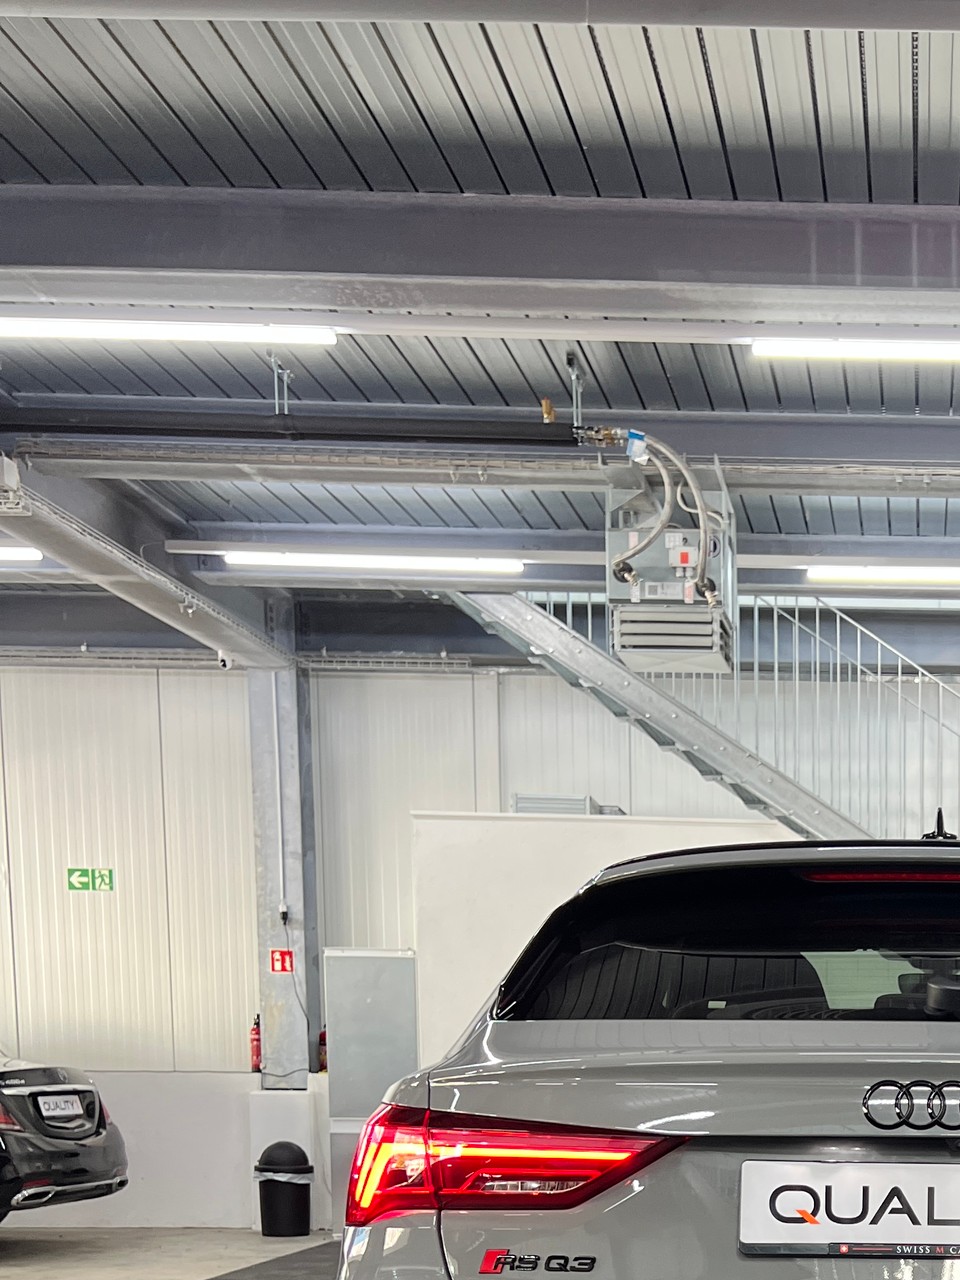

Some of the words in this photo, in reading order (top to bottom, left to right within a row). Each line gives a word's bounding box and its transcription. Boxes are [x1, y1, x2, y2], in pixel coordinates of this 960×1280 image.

[896, 1245, 931, 1254] SWISS
[935, 1246, 945, 1254] M
[492, 1254, 541, 1272] RS
[544, 1254, 597, 1273] Q3
